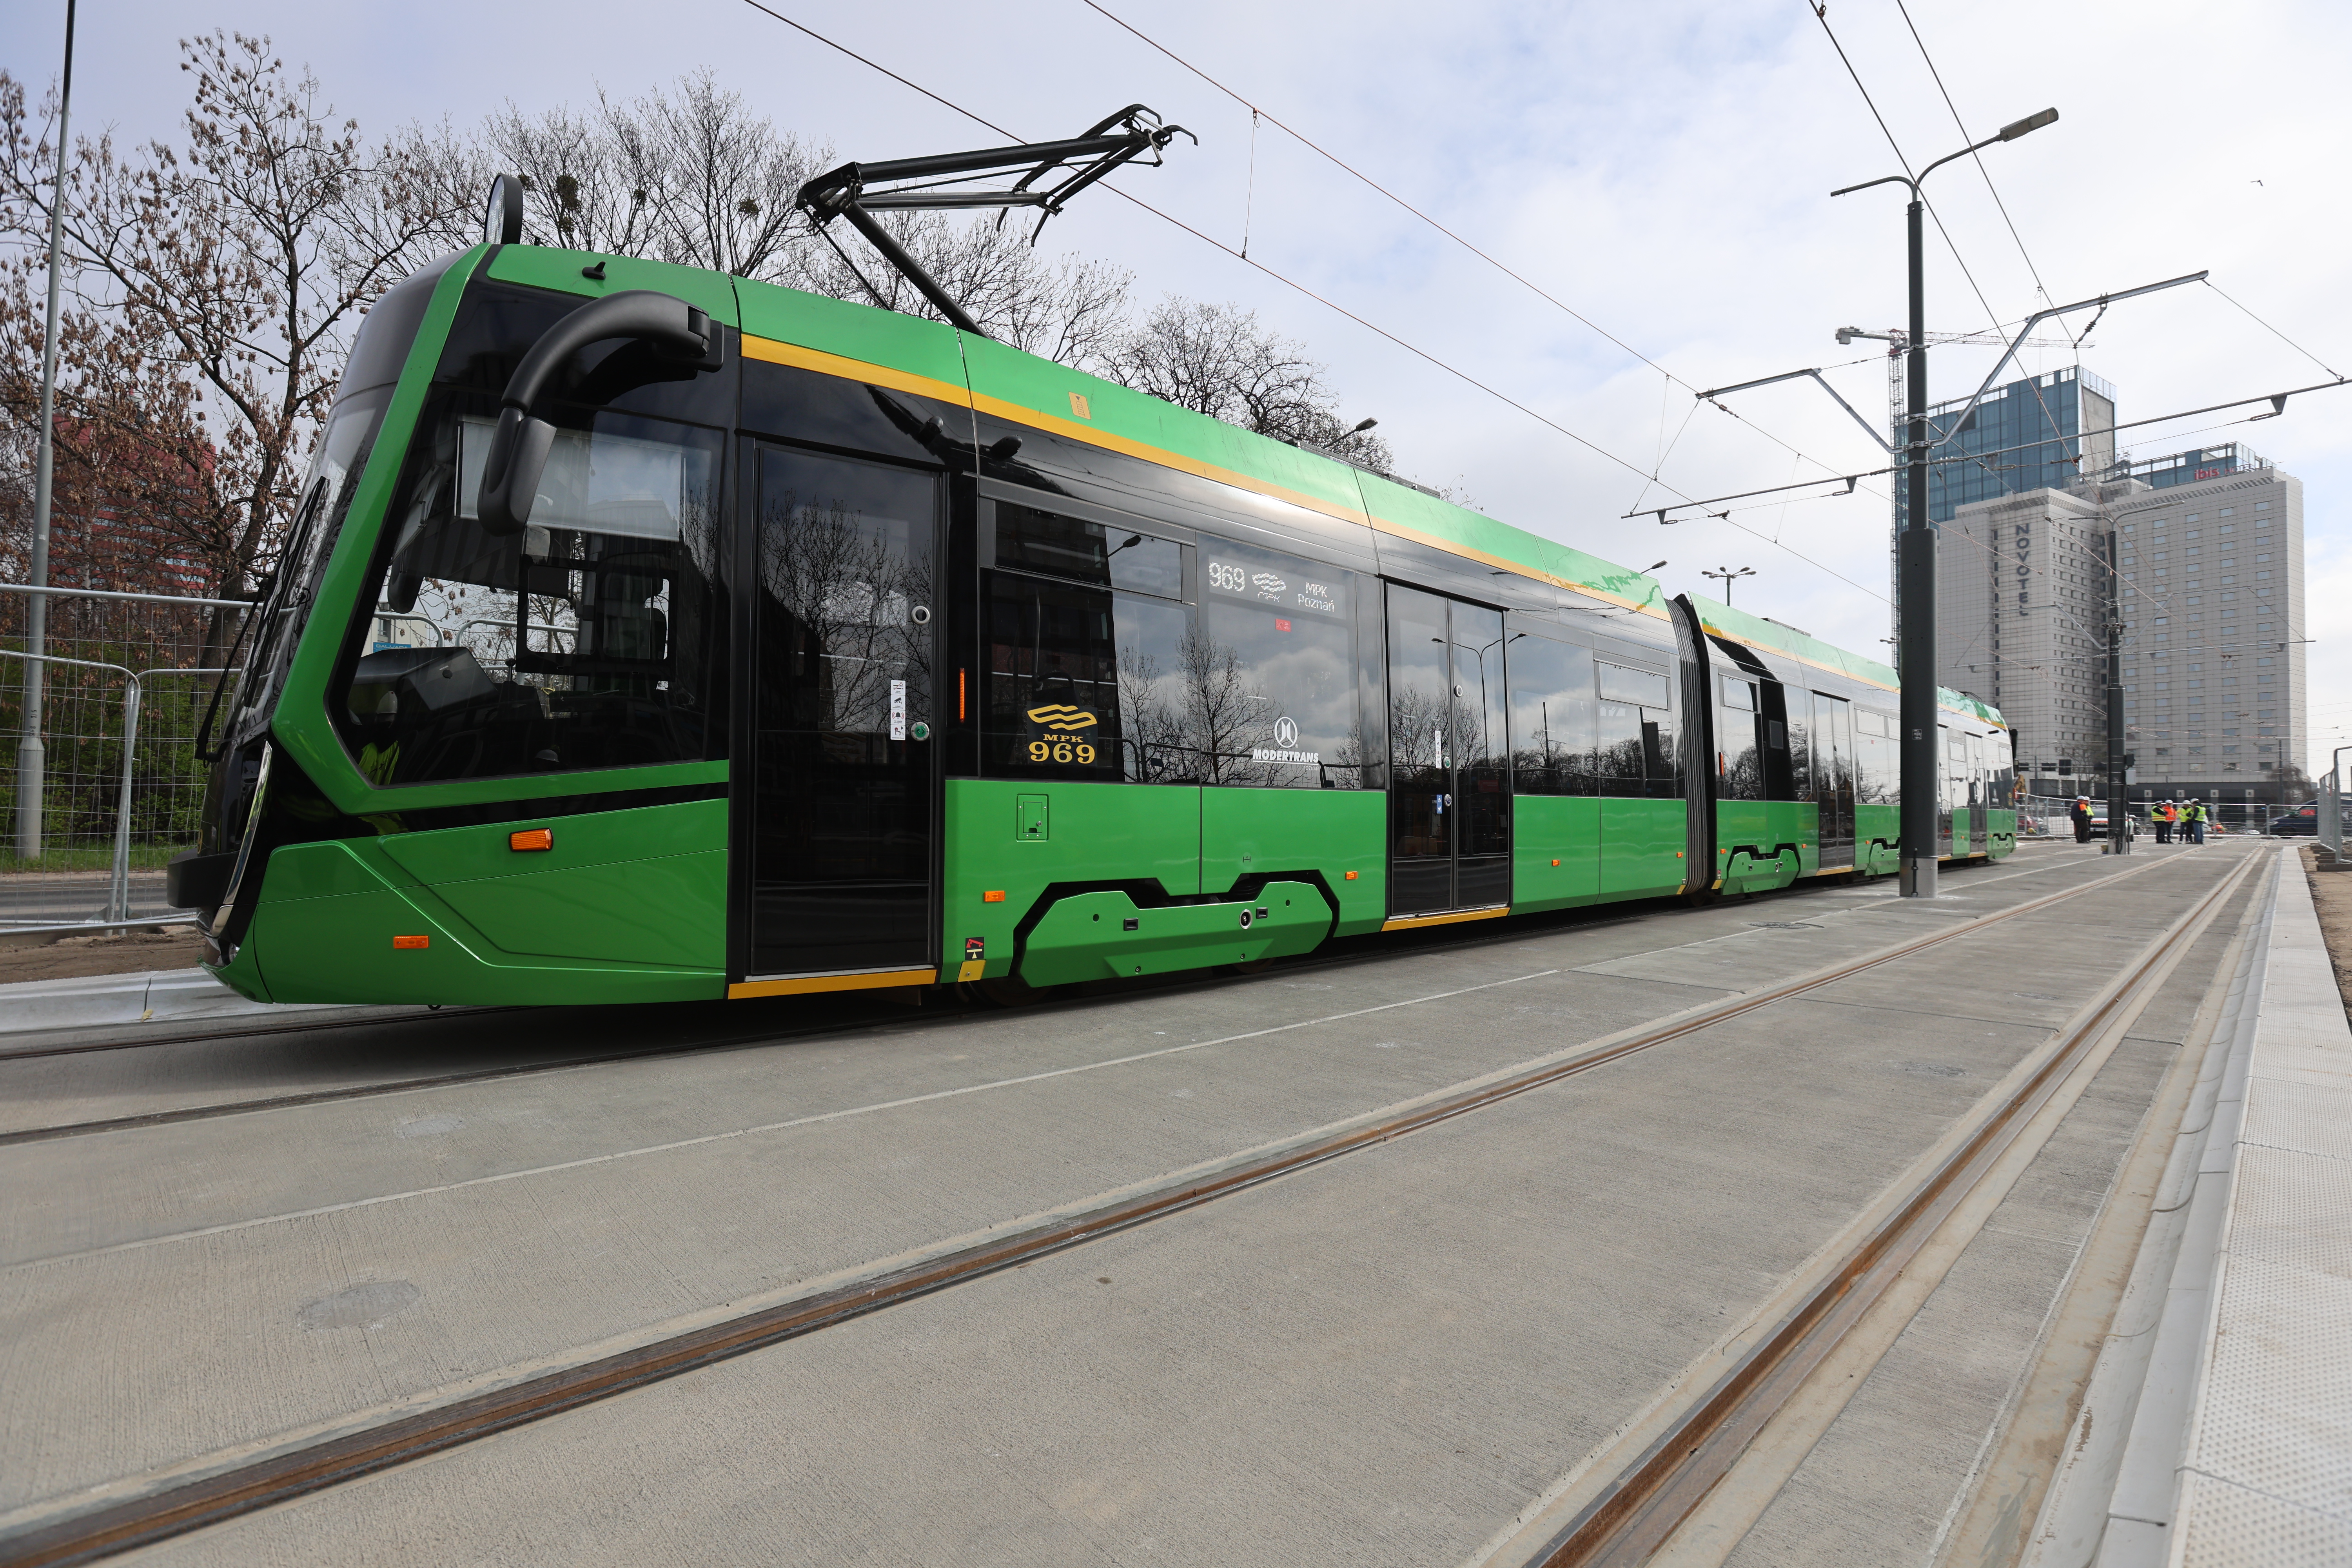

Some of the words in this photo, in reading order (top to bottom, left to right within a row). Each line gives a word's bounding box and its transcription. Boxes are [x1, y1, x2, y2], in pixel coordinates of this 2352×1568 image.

[2194, 467, 2220, 480] ibis
[2224, 463, 2255, 474] HOTEL
[1209, 562, 1245, 592] 969
[2015, 523, 2030, 616] NOVOTEL
[1306, 582, 1328, 598] MPK
[1298, 593, 1335, 612] Poznań
[1043, 734, 1084, 743] MPK
[1029, 741, 1095, 764] 969
[1252, 749, 1319, 763] MODERTRANS
